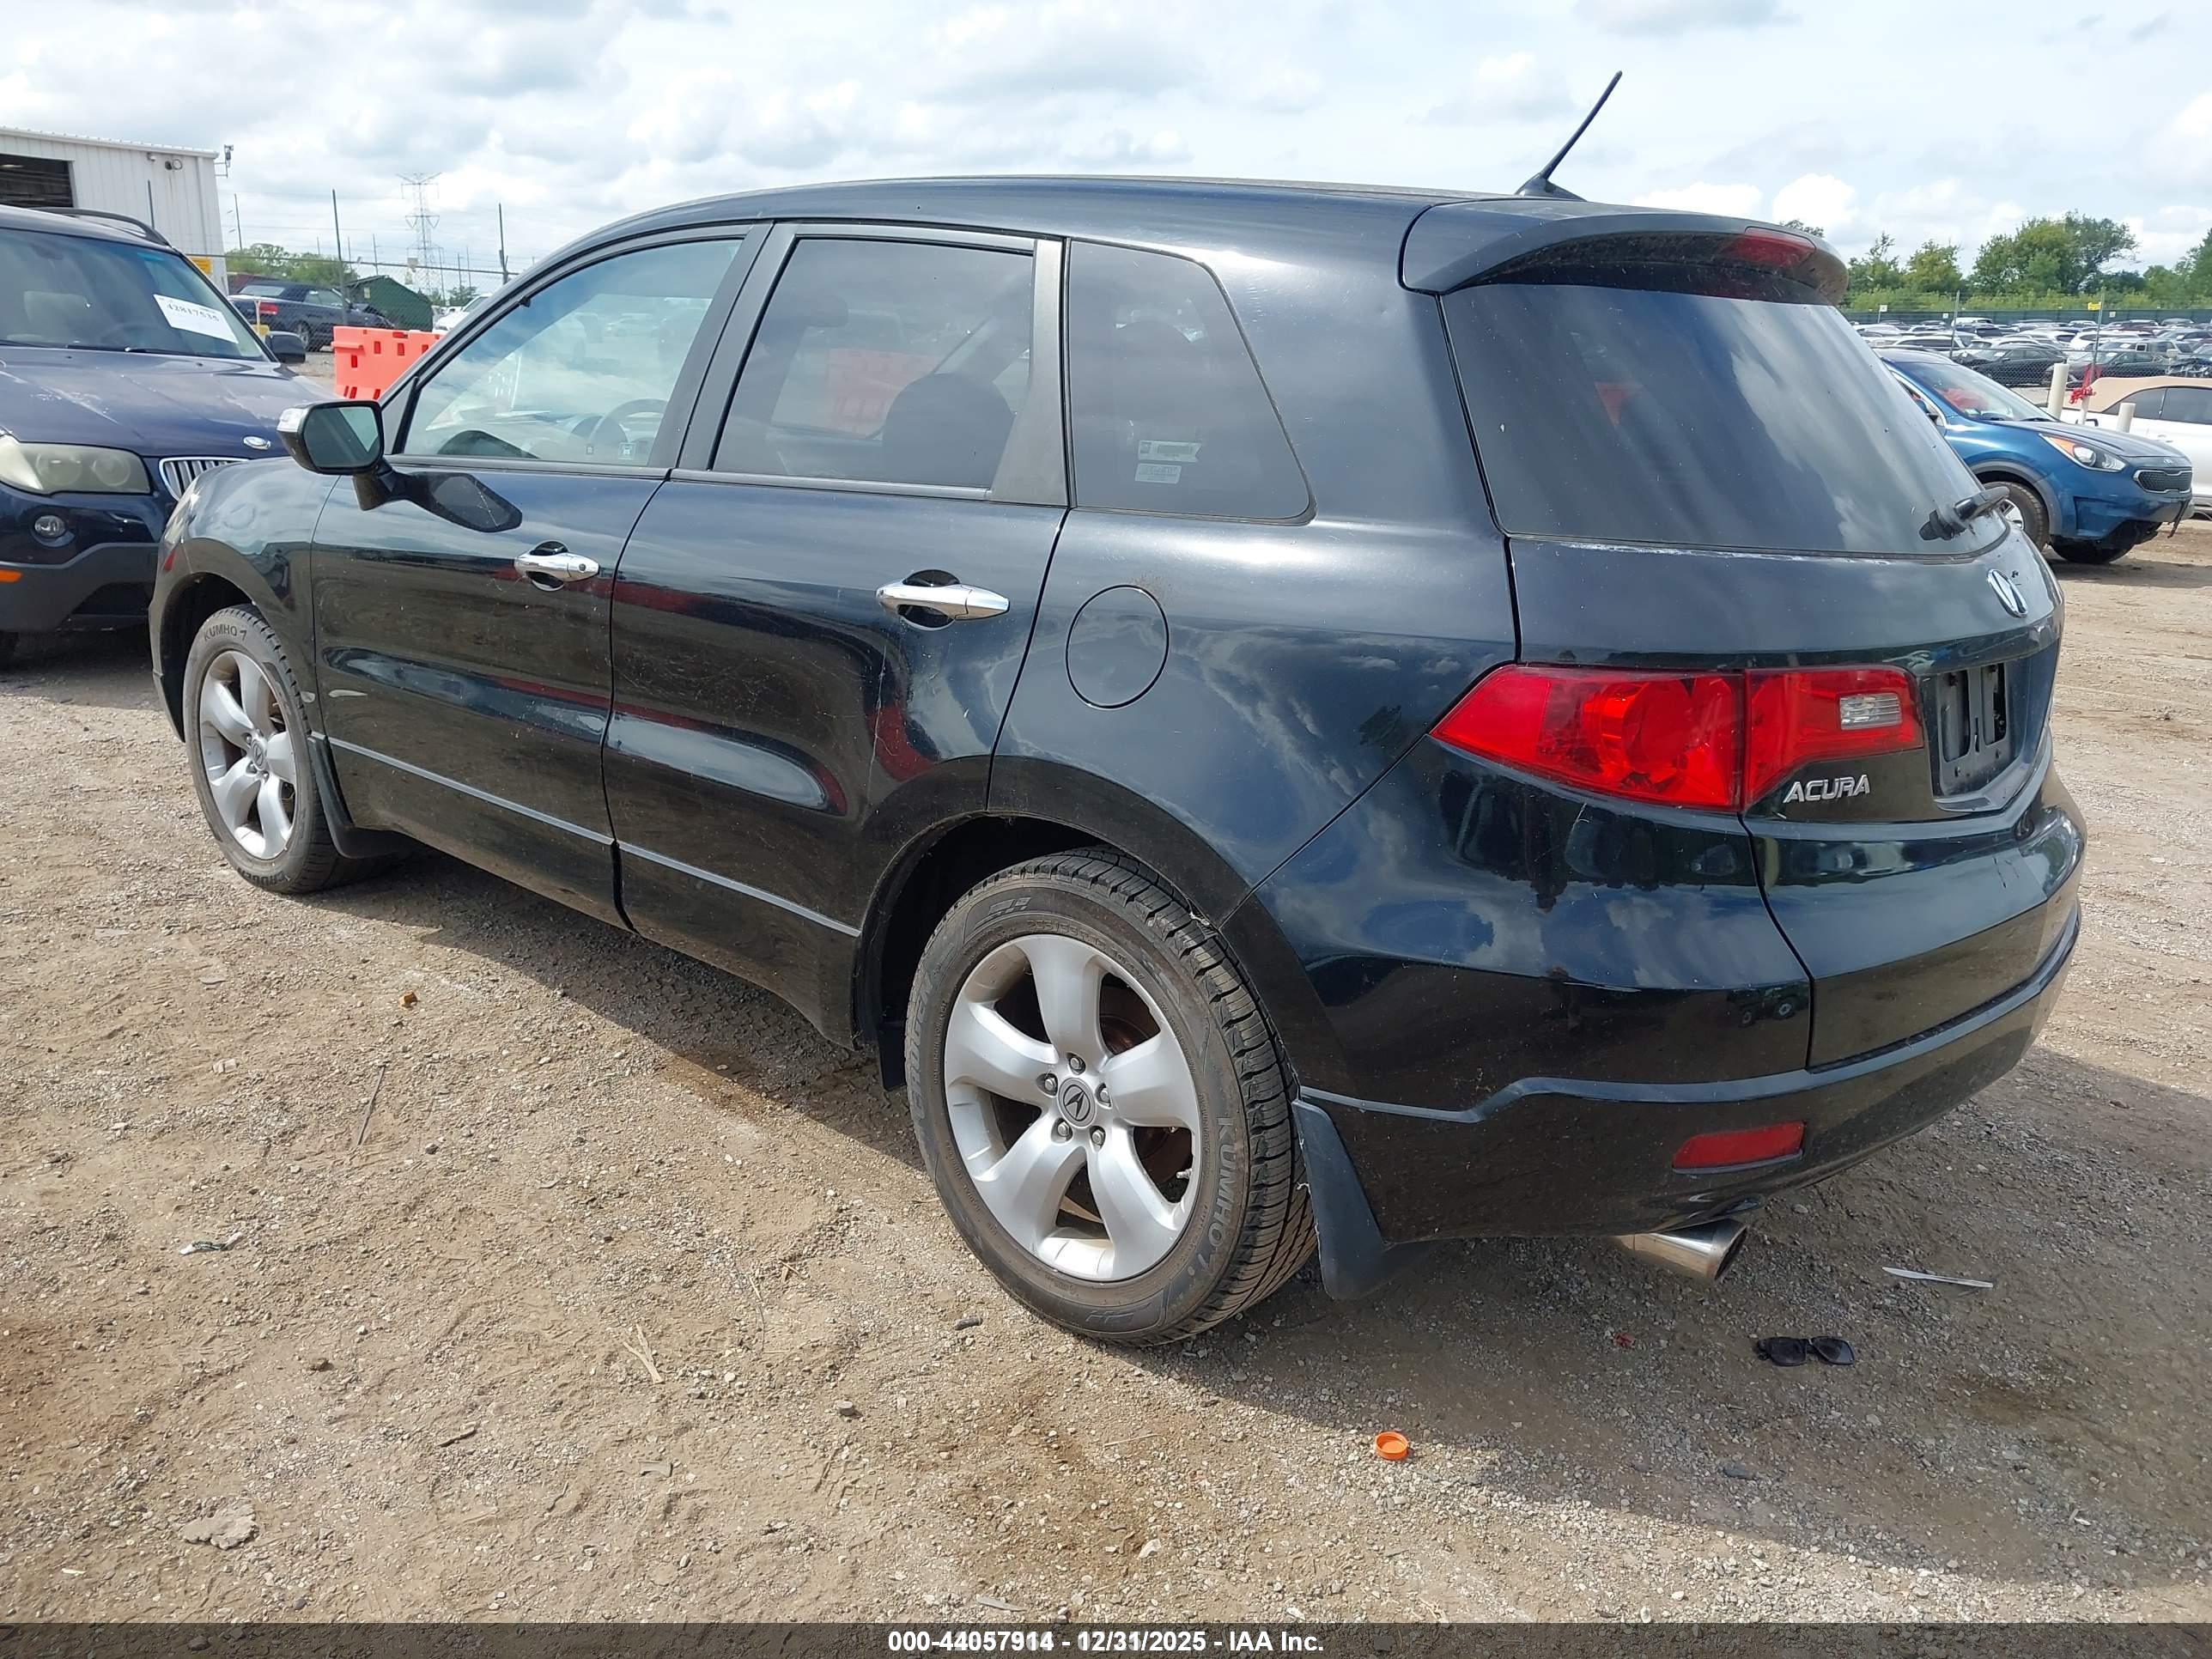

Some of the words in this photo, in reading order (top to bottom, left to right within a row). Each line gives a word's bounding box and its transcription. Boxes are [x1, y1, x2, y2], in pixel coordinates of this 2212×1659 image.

[204, 623, 238, 641] KUMHO
[1782, 774, 1870, 804] ACURA
[1207, 1117, 1237, 1248] KUMHO
